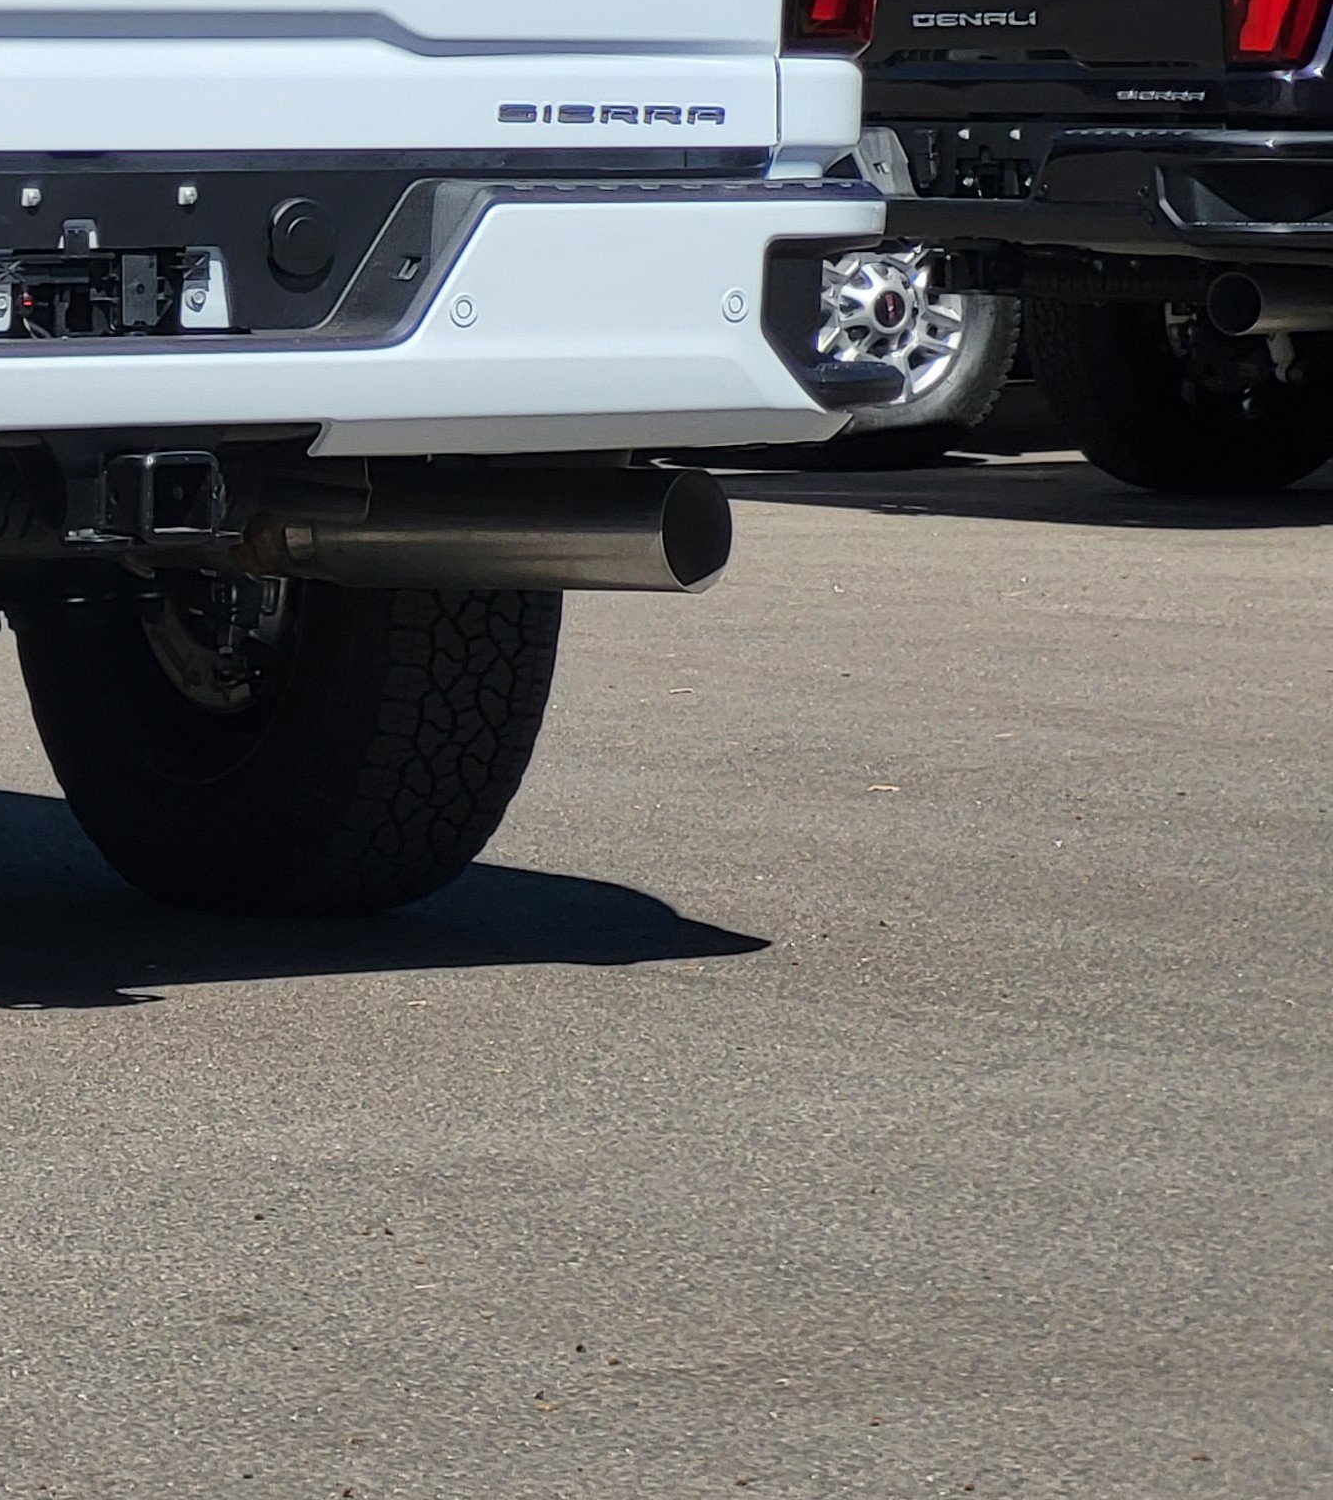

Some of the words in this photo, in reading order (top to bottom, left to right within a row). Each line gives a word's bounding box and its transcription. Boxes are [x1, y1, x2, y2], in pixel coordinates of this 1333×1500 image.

[912, 11, 1037, 27] DENALI
[1116, 90, 1206, 101] SIERRA
[498, 103, 726, 125] SIERRA
